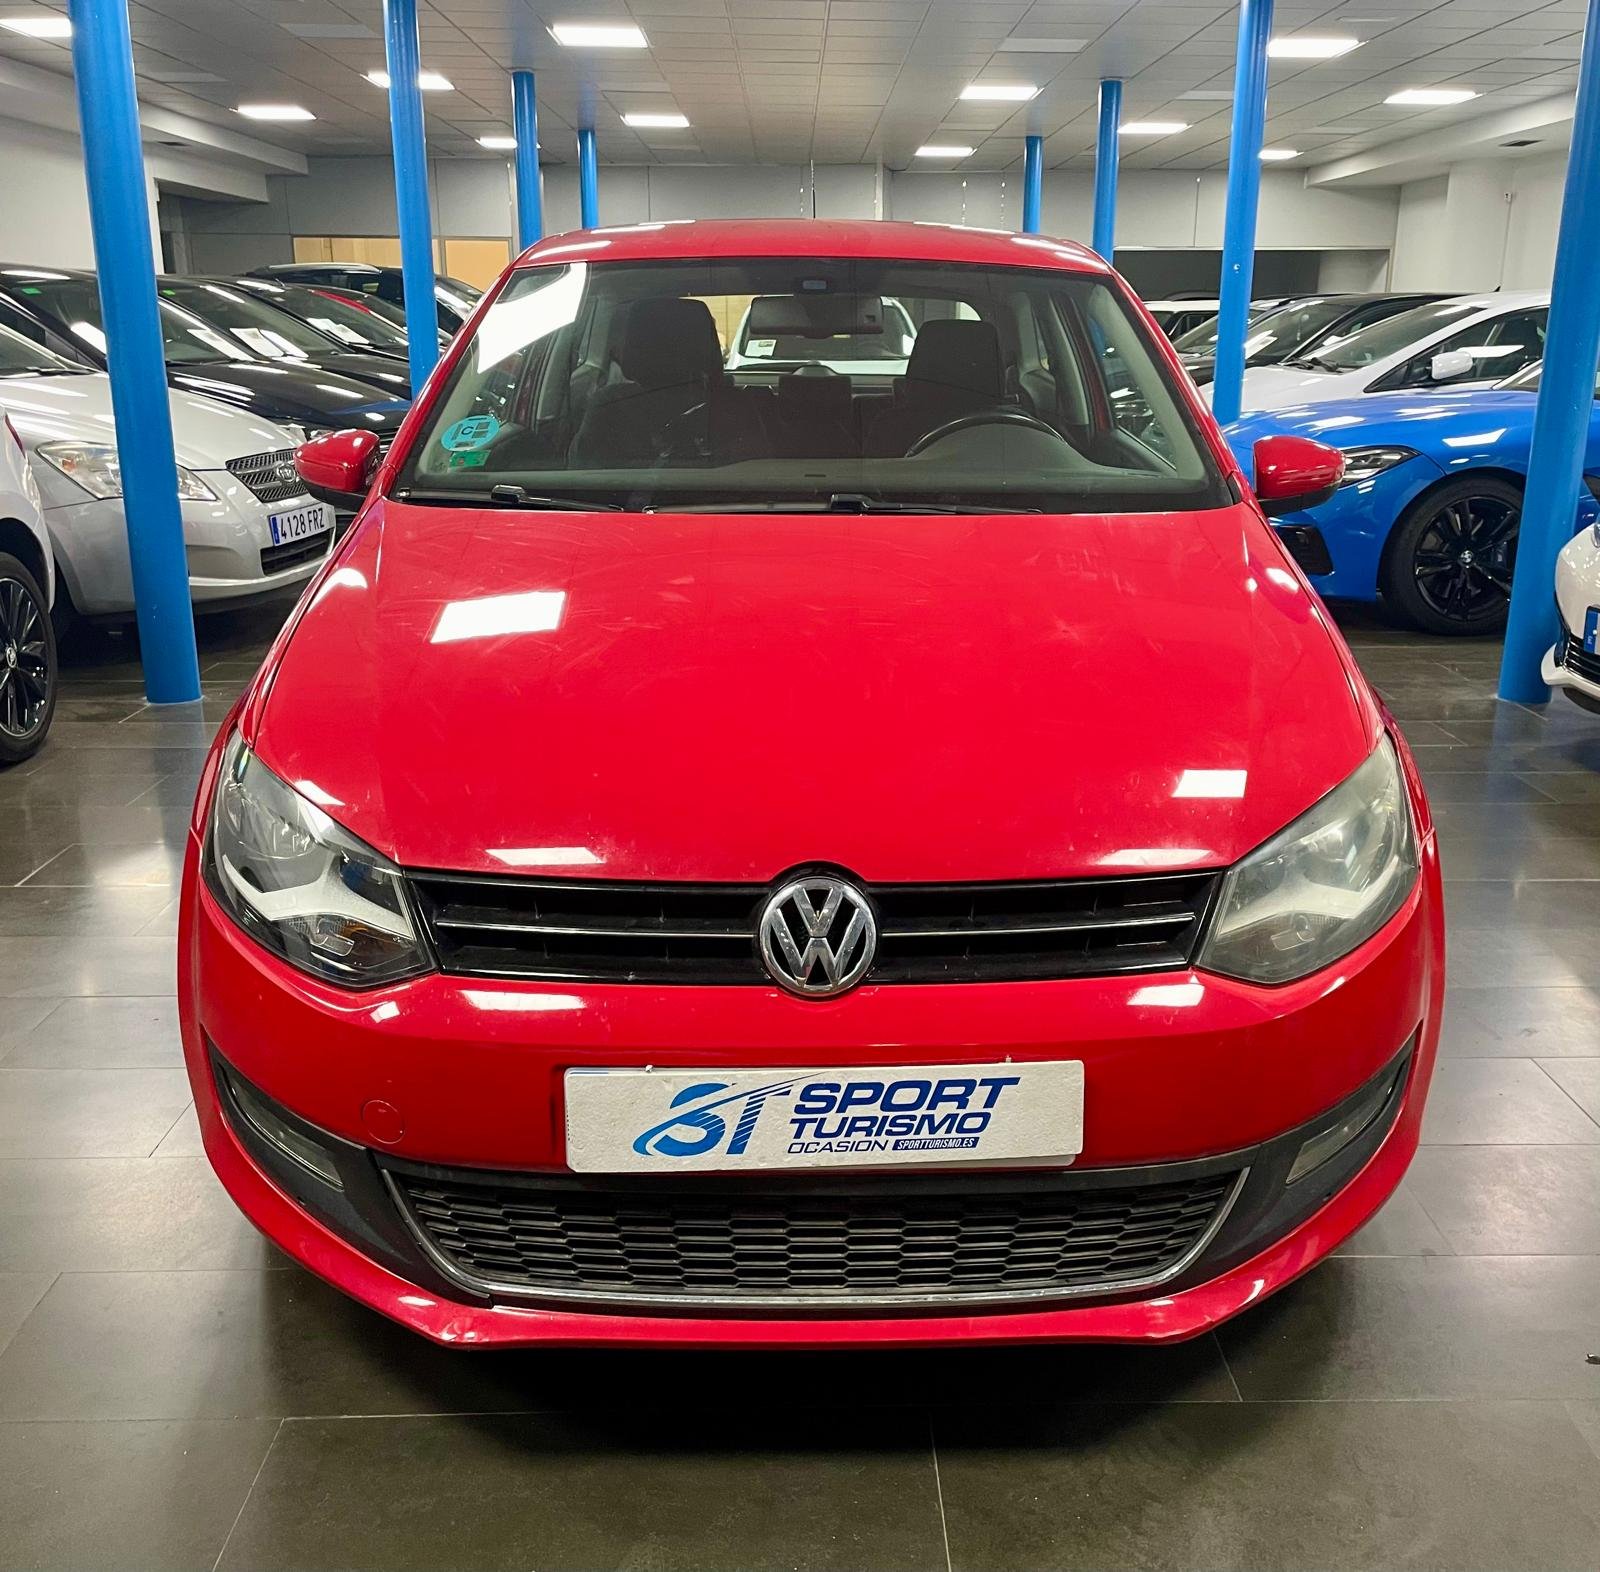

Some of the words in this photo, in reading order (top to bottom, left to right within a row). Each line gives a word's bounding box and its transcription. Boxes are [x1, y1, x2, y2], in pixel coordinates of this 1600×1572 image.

[281, 514, 306, 539] 4128
[307, 508, 324, 532] FRZ
[768, 883, 867, 988] VW
[793, 1076, 1021, 1115] SPORT
[789, 1111, 992, 1140] TURISMO
[788, 1139, 889, 1154] OCASION
[897, 1137, 975, 1151] SPORTTURISMO.ES
